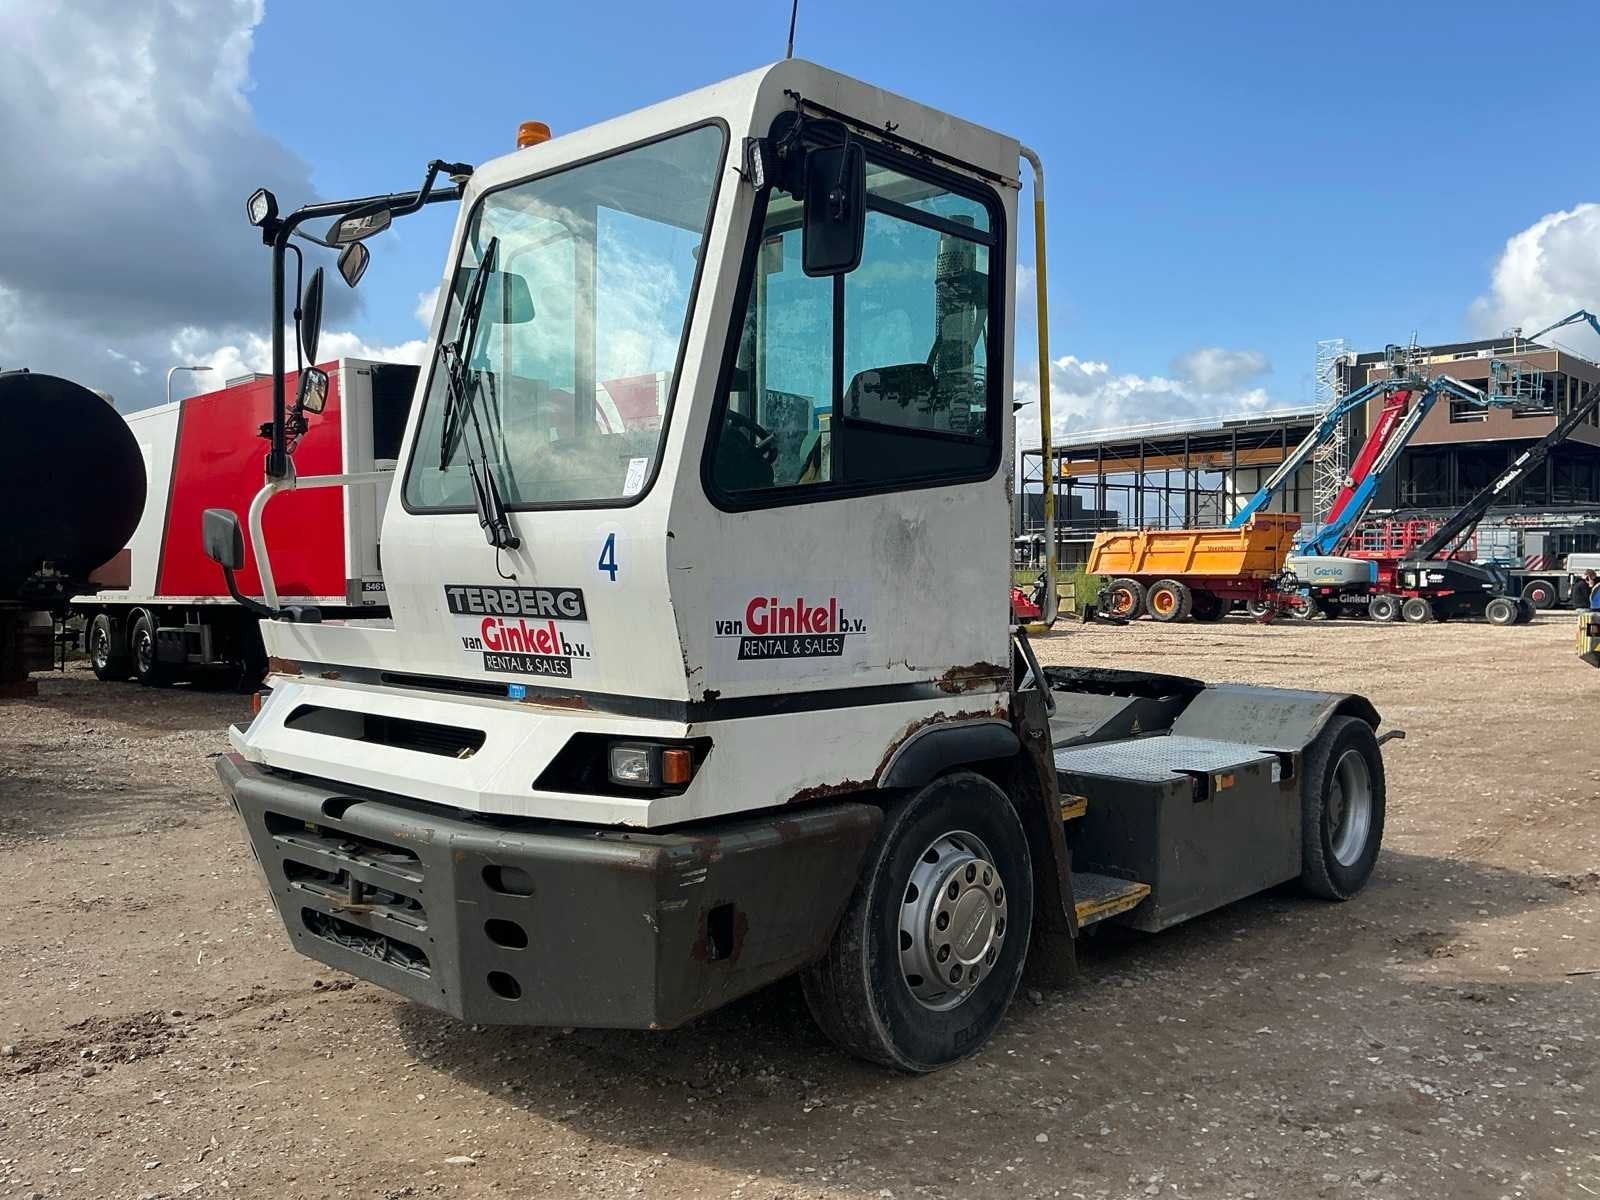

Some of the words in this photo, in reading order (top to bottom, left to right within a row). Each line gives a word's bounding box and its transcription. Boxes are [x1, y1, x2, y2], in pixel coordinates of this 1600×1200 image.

[599, 533, 618, 581] 4
[447, 587, 581, 617] TERBERG
[716, 619, 742, 635] van
[745, 597, 837, 635] Ginkel
[840, 608, 867, 633] b.v.
[462, 636, 483, 649] van
[481, 616, 561, 655] Ginkel
[560, 631, 590, 657] b.v.
[743, 639, 788, 656] RENTAL
[792, 639, 801, 655] &
[805, 638, 840, 654] SALES
[486, 655, 524, 671] RENTAL
[526, 658, 534, 671] &
[536, 658, 568, 675] SALES
